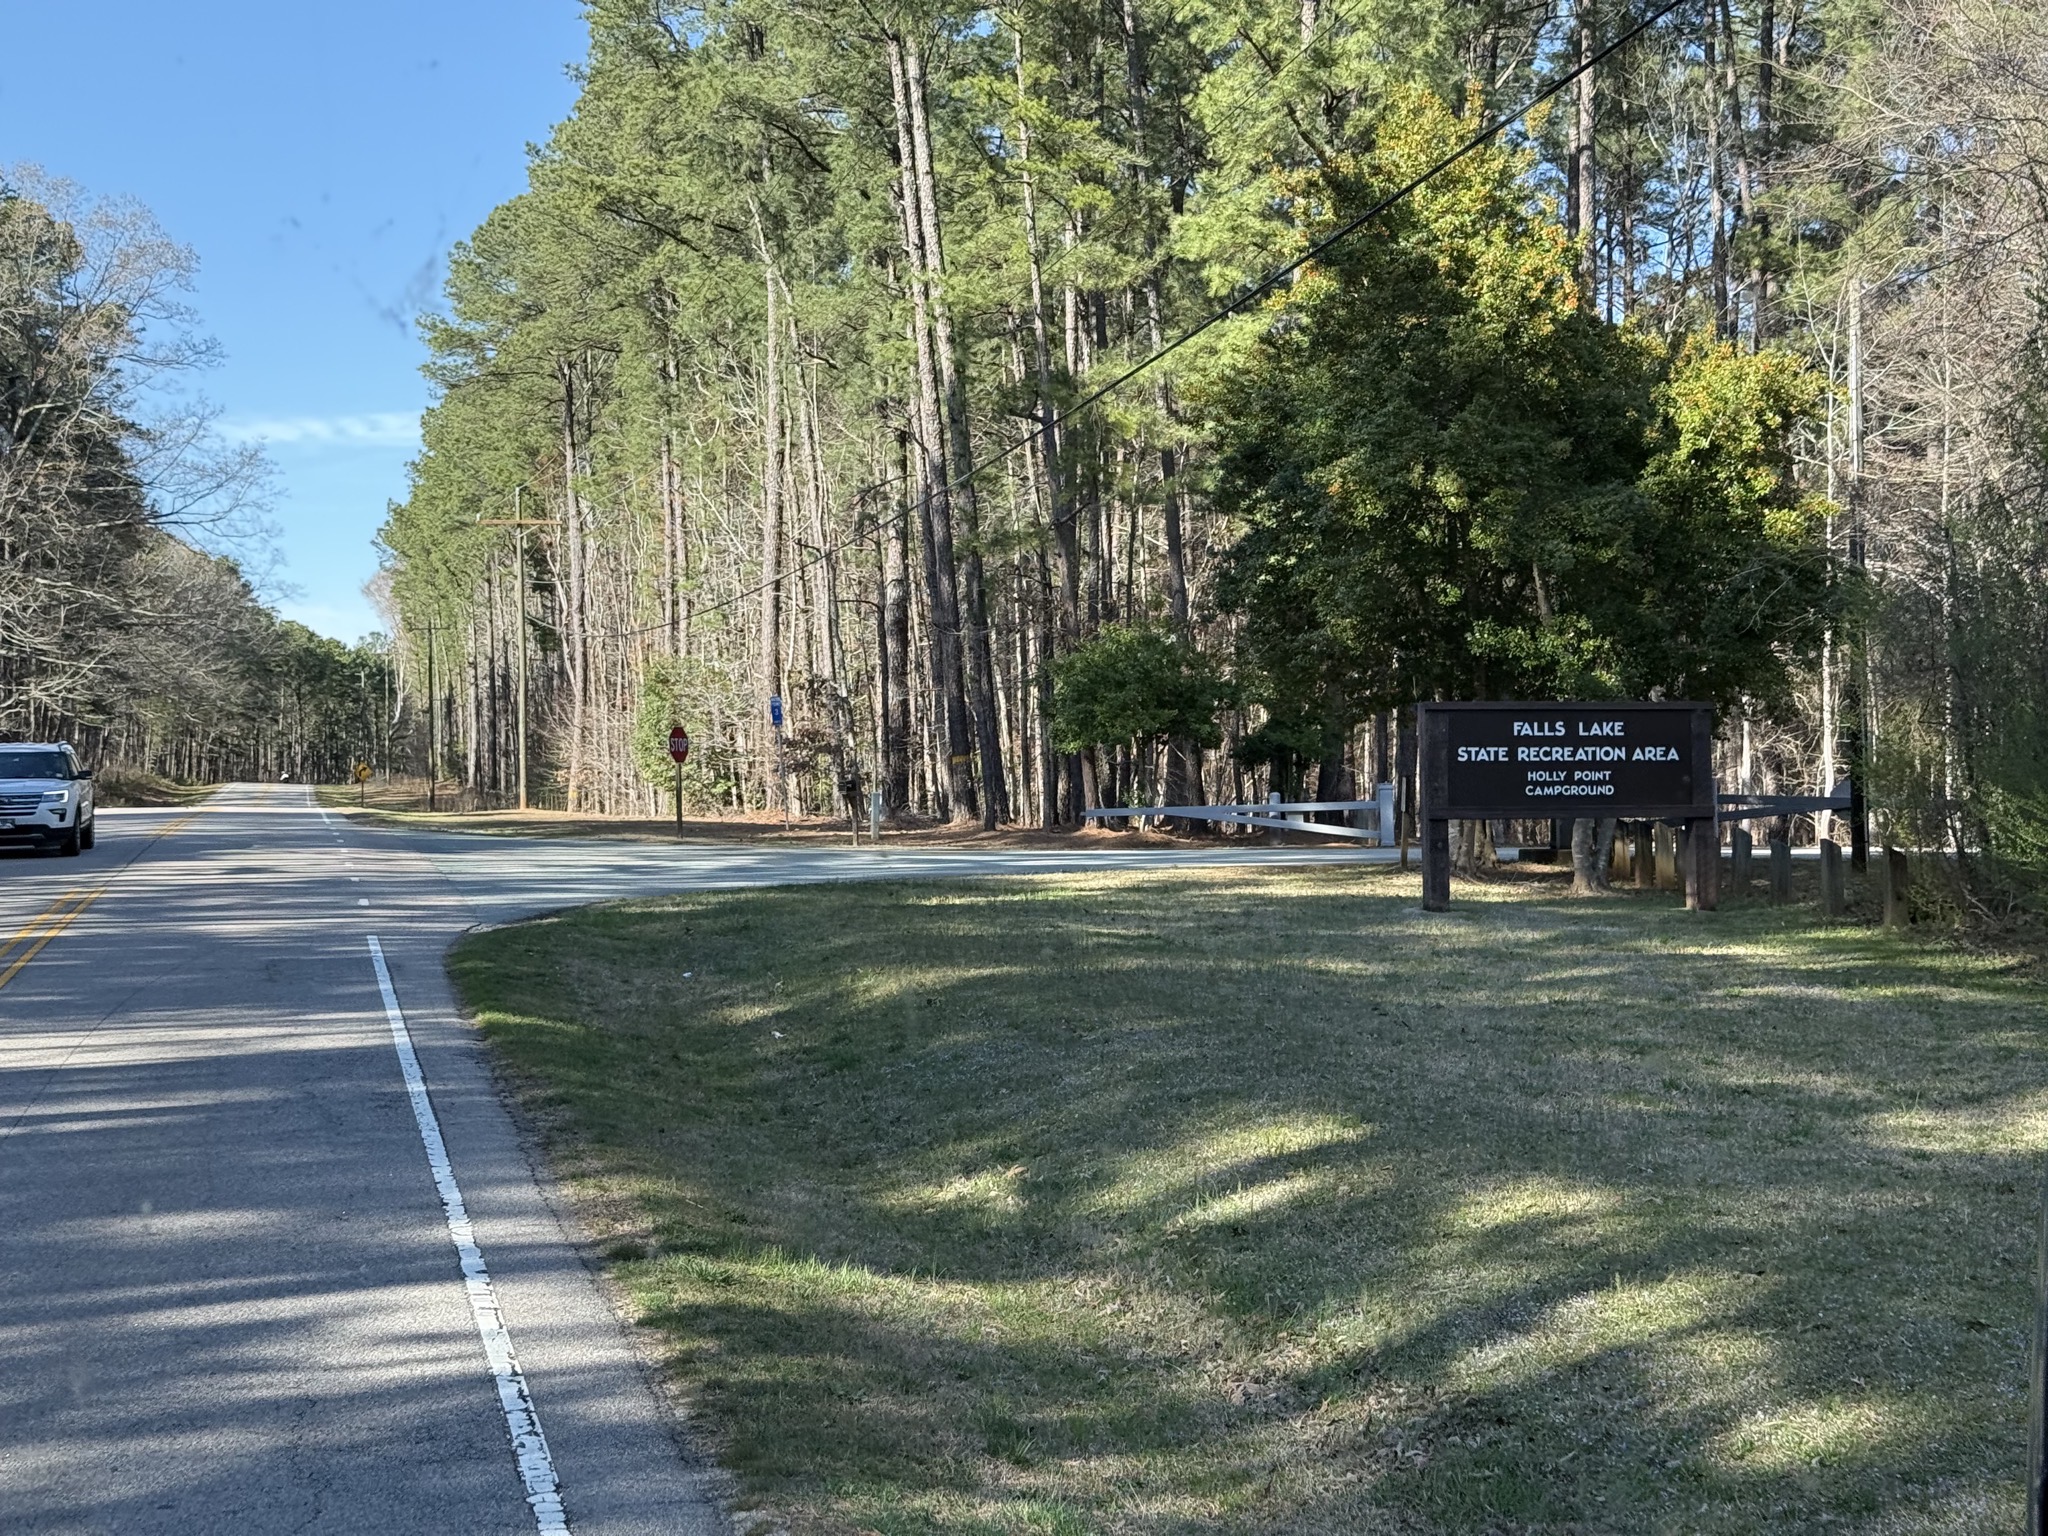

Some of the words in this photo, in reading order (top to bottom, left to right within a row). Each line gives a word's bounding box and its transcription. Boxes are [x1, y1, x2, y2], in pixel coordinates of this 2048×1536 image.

[1513, 721, 1566, 736] FALLS
[1578, 721, 1625, 736] LAKE
[671, 737, 688, 752] STOP
[1457, 746, 1509, 762] STATE
[1517, 746, 1626, 762] RECREATION
[1631, 746, 1680, 761] AREA
[1527, 771, 1567, 782] HOLLY
[1574, 770, 1612, 781] POINT
[1525, 785, 1615, 796] CAMPGROUND
